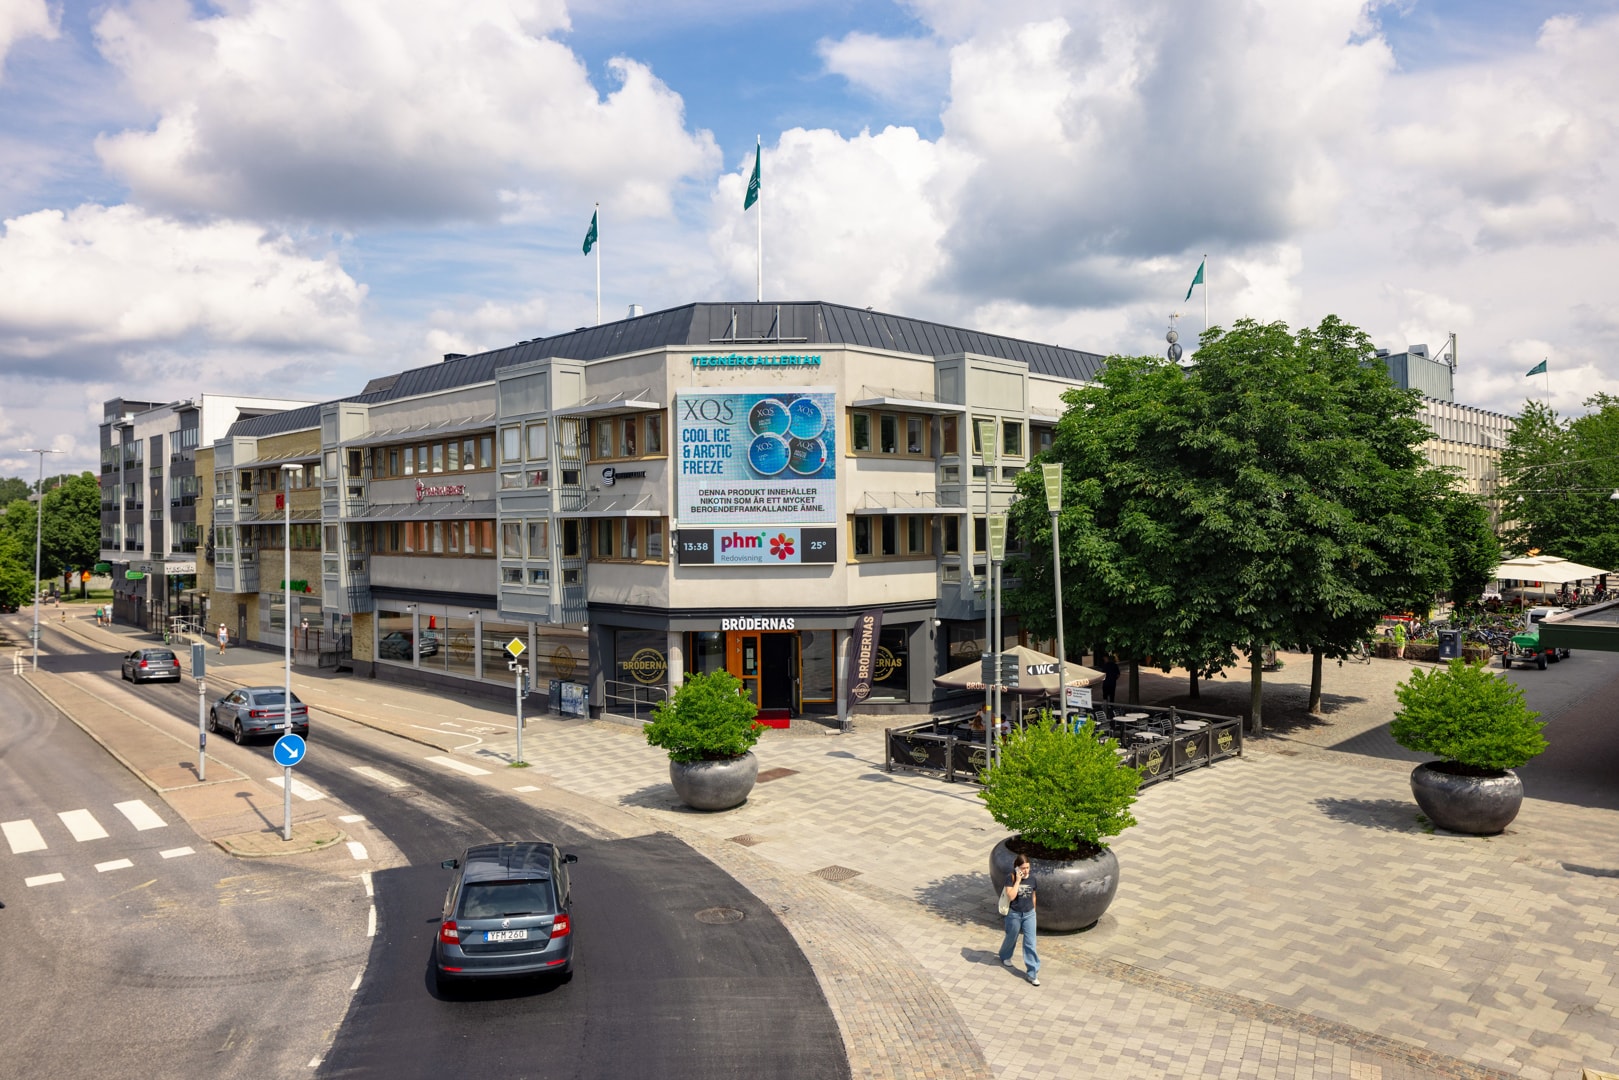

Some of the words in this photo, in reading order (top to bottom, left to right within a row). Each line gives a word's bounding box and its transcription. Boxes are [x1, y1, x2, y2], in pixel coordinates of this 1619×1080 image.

[691, 354, 821, 366] TEGNÉRGALLERIAN
[683, 399, 737, 425] XQS
[683, 428, 712, 443] COOL
[713, 428, 731, 443] ICE
[683, 444, 691, 458] &
[693, 444, 732, 458] ARCTIC
[683, 460, 724, 474] FREEZE
[767, 487, 817, 496] INNEHÅLLER
[753, 496, 765, 504] ÄR
[690, 505, 798, 513] BEROENDEFRAMKALLANDE
[800, 504, 825, 512] ÄMNE.
[684, 542, 709, 551] 13:38
[721, 532, 763, 552] phm
[811, 541, 827, 550] 25°
[721, 554, 763, 562] Redovisning
[721, 616, 795, 630] BRÖDERNAS
[858, 616, 874, 678] BRÖDERNAS
[623, 660, 668, 670] BRÖDERNA
[1036, 663, 1054, 674] WC
[490, 930, 507, 940] YFM
[508, 930, 524, 939] 260
